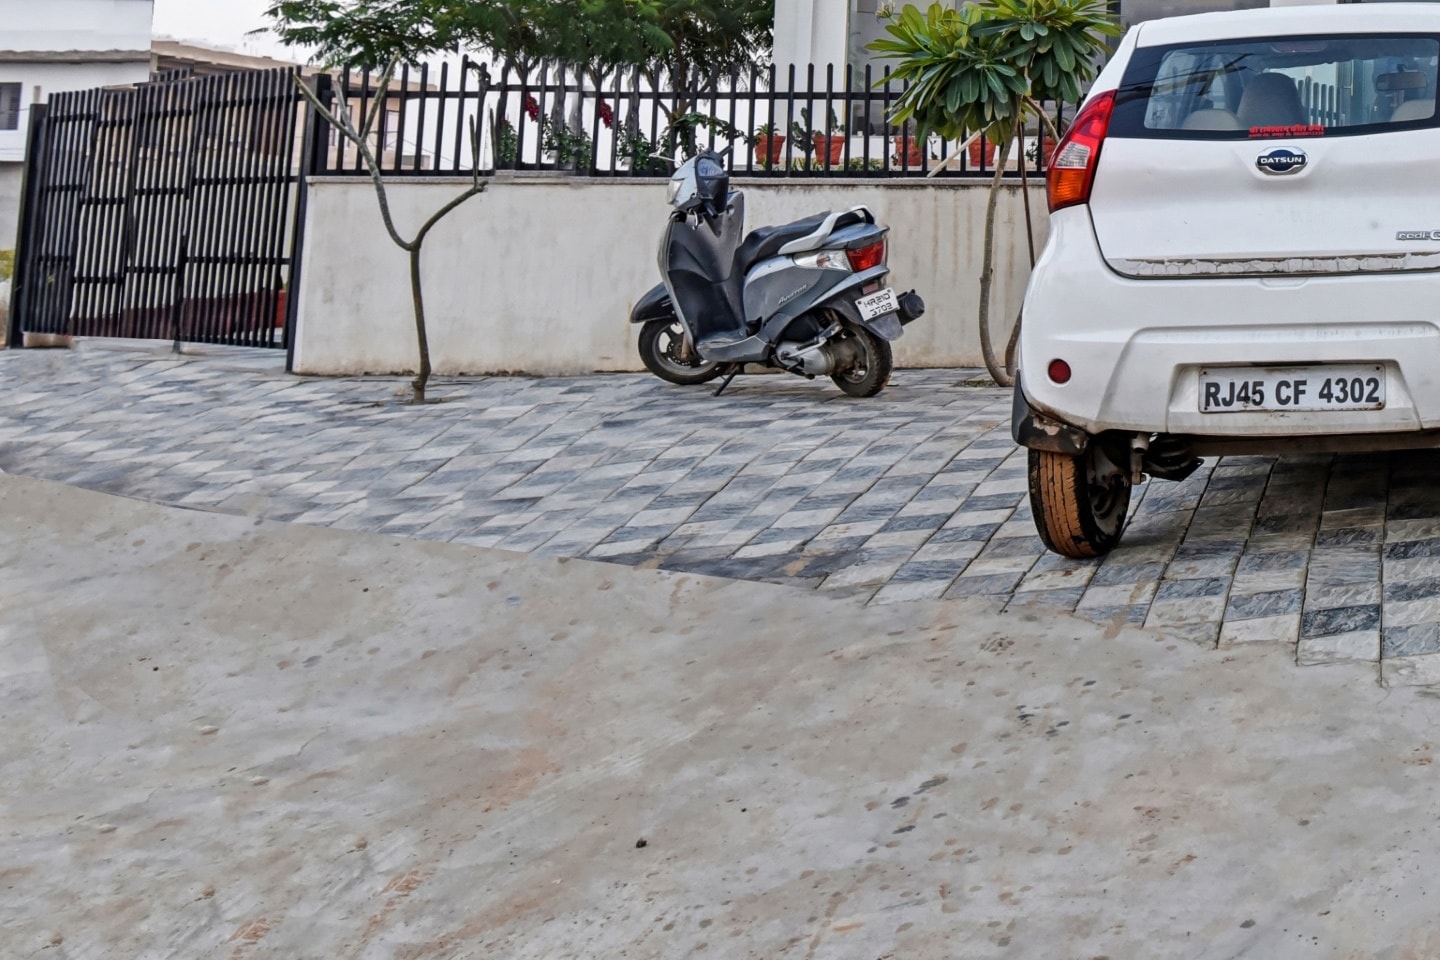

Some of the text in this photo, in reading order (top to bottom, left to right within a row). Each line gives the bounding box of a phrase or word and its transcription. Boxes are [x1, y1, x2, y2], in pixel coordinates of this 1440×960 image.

[1260, 156, 1302, 164] DATSUN
[1205, 377, 1380, 407] RJ45 CF 4302
